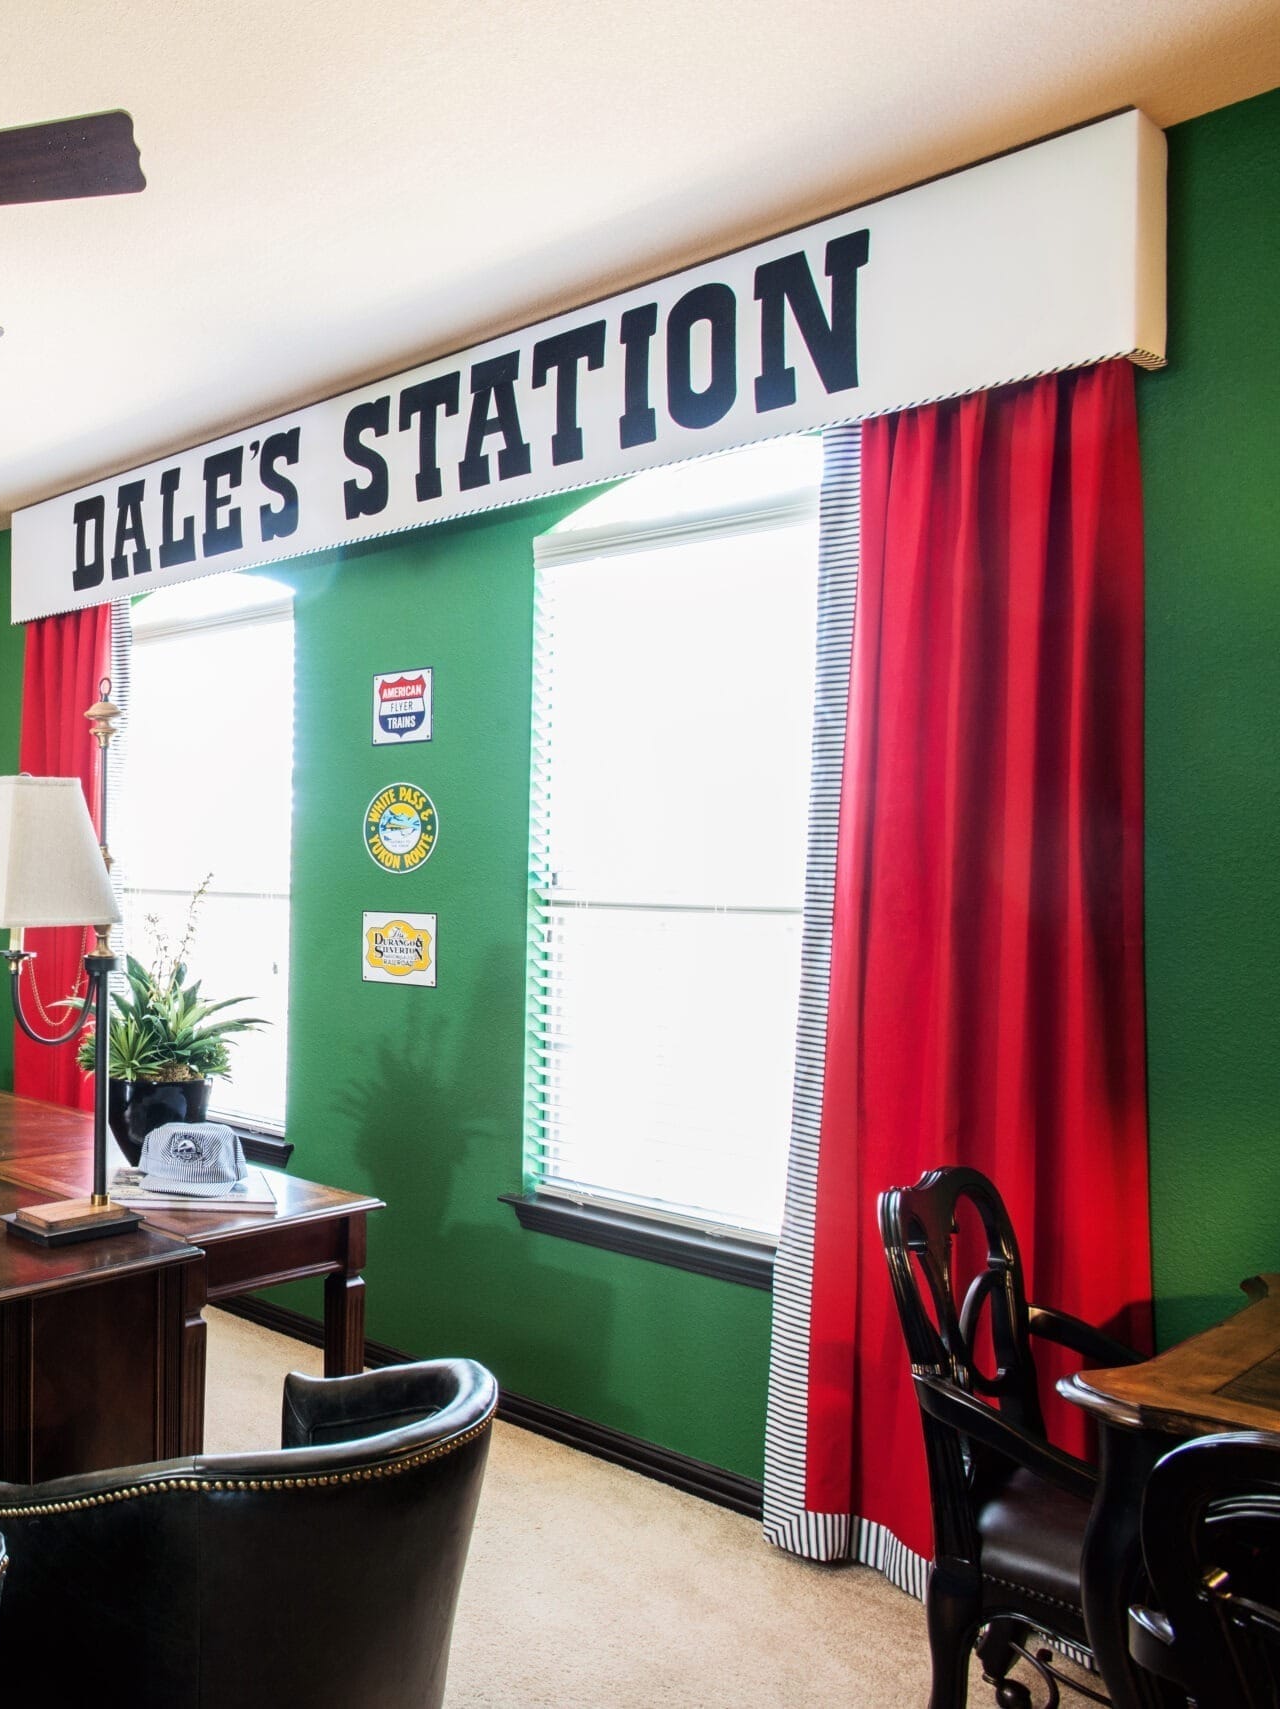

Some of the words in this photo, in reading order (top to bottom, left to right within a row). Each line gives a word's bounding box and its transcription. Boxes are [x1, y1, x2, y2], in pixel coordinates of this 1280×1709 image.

[72, 426, 302, 592] DALE'S
[343, 228, 871, 521] STATION
[382, 684, 423, 699] AMERICAN
[390, 700, 414, 712] FLYER
[387, 715, 416, 730] TRAINS
[368, 788, 397, 822] WHITE
[399, 786, 426, 810] PASS
[369, 833, 401, 869] YUKON
[403, 832, 434, 868] ROUTE
[375, 932, 415, 947] DURANGO
[375, 945, 423, 961] SILVERTON
